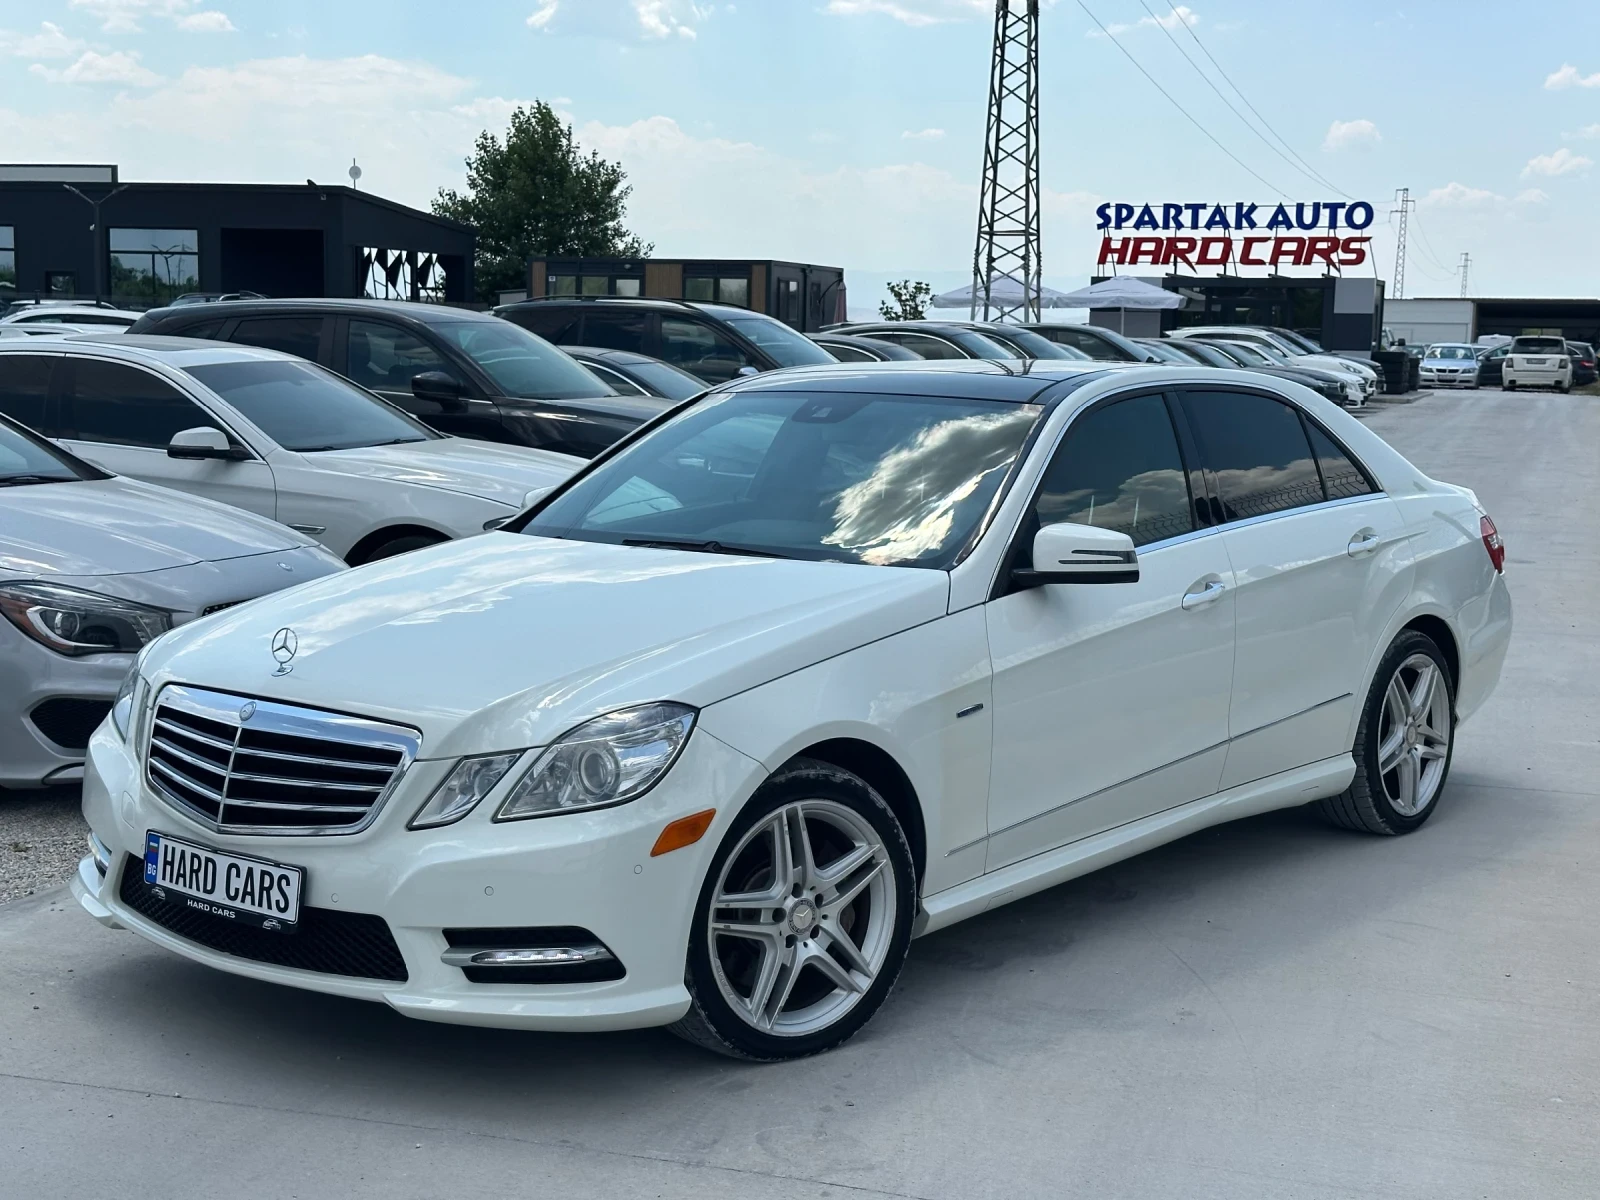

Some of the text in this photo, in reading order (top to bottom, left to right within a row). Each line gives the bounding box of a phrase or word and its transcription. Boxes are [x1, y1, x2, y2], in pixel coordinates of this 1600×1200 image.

[1096, 201, 1374, 230] SPARTAK AUTO
[1097, 236, 1373, 275] HARD CARS
[147, 863, 157, 876] BG
[162, 844, 290, 913] HARD CARS
[187, 899, 236, 918] HARD CARS
